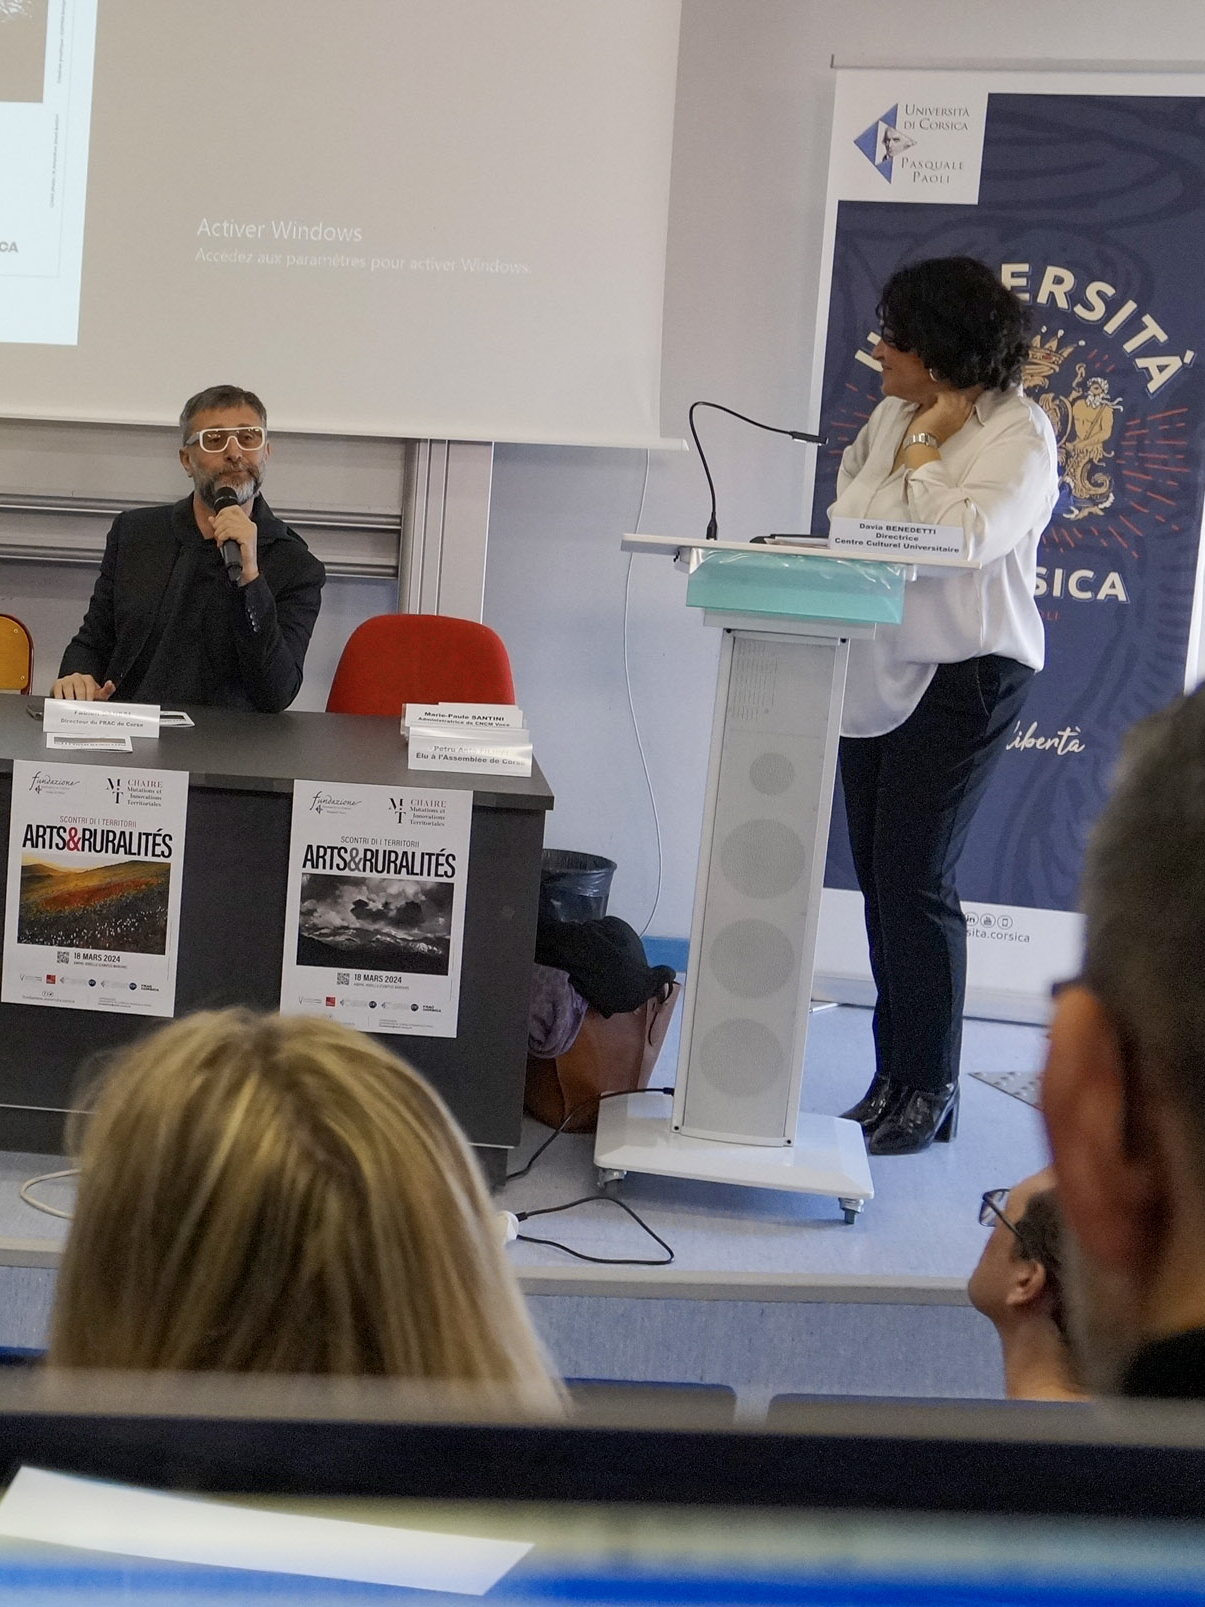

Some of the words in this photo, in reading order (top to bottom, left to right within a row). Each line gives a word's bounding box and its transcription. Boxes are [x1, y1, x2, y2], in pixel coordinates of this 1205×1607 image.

[196, 217, 265, 239] Activer
[271, 219, 362, 242] Windows
[370, 258, 404, 271] pour
[859, 523, 883, 531] Davia
[885, 525, 936, 535] BENEDETTI
[876, 532, 919, 542] Directrice
[834, 537, 864, 546] Centre
[866, 539, 901, 549] Culturel
[903, 543, 960, 553] Universitaire
[424, 711, 469, 720] Marie-Paule
[128, 779, 163, 788] CHAIRE
[410, 799, 447, 808] CHAIRE
[60, 815, 87, 824] SCONTRI
[89, 817, 96, 825] DI
[102, 818, 137, 828] TERRITORII
[341, 836, 369, 844] SCONTRI
[371, 837, 378, 845] DI
[384, 838, 420, 848] TERRITORII
[82, 953, 101, 961] MARS
[103, 954, 120, 963] 2024
[354, 973, 362, 981] 18
[363, 974, 382, 983] MARS
[384, 975, 402, 984] 2024
